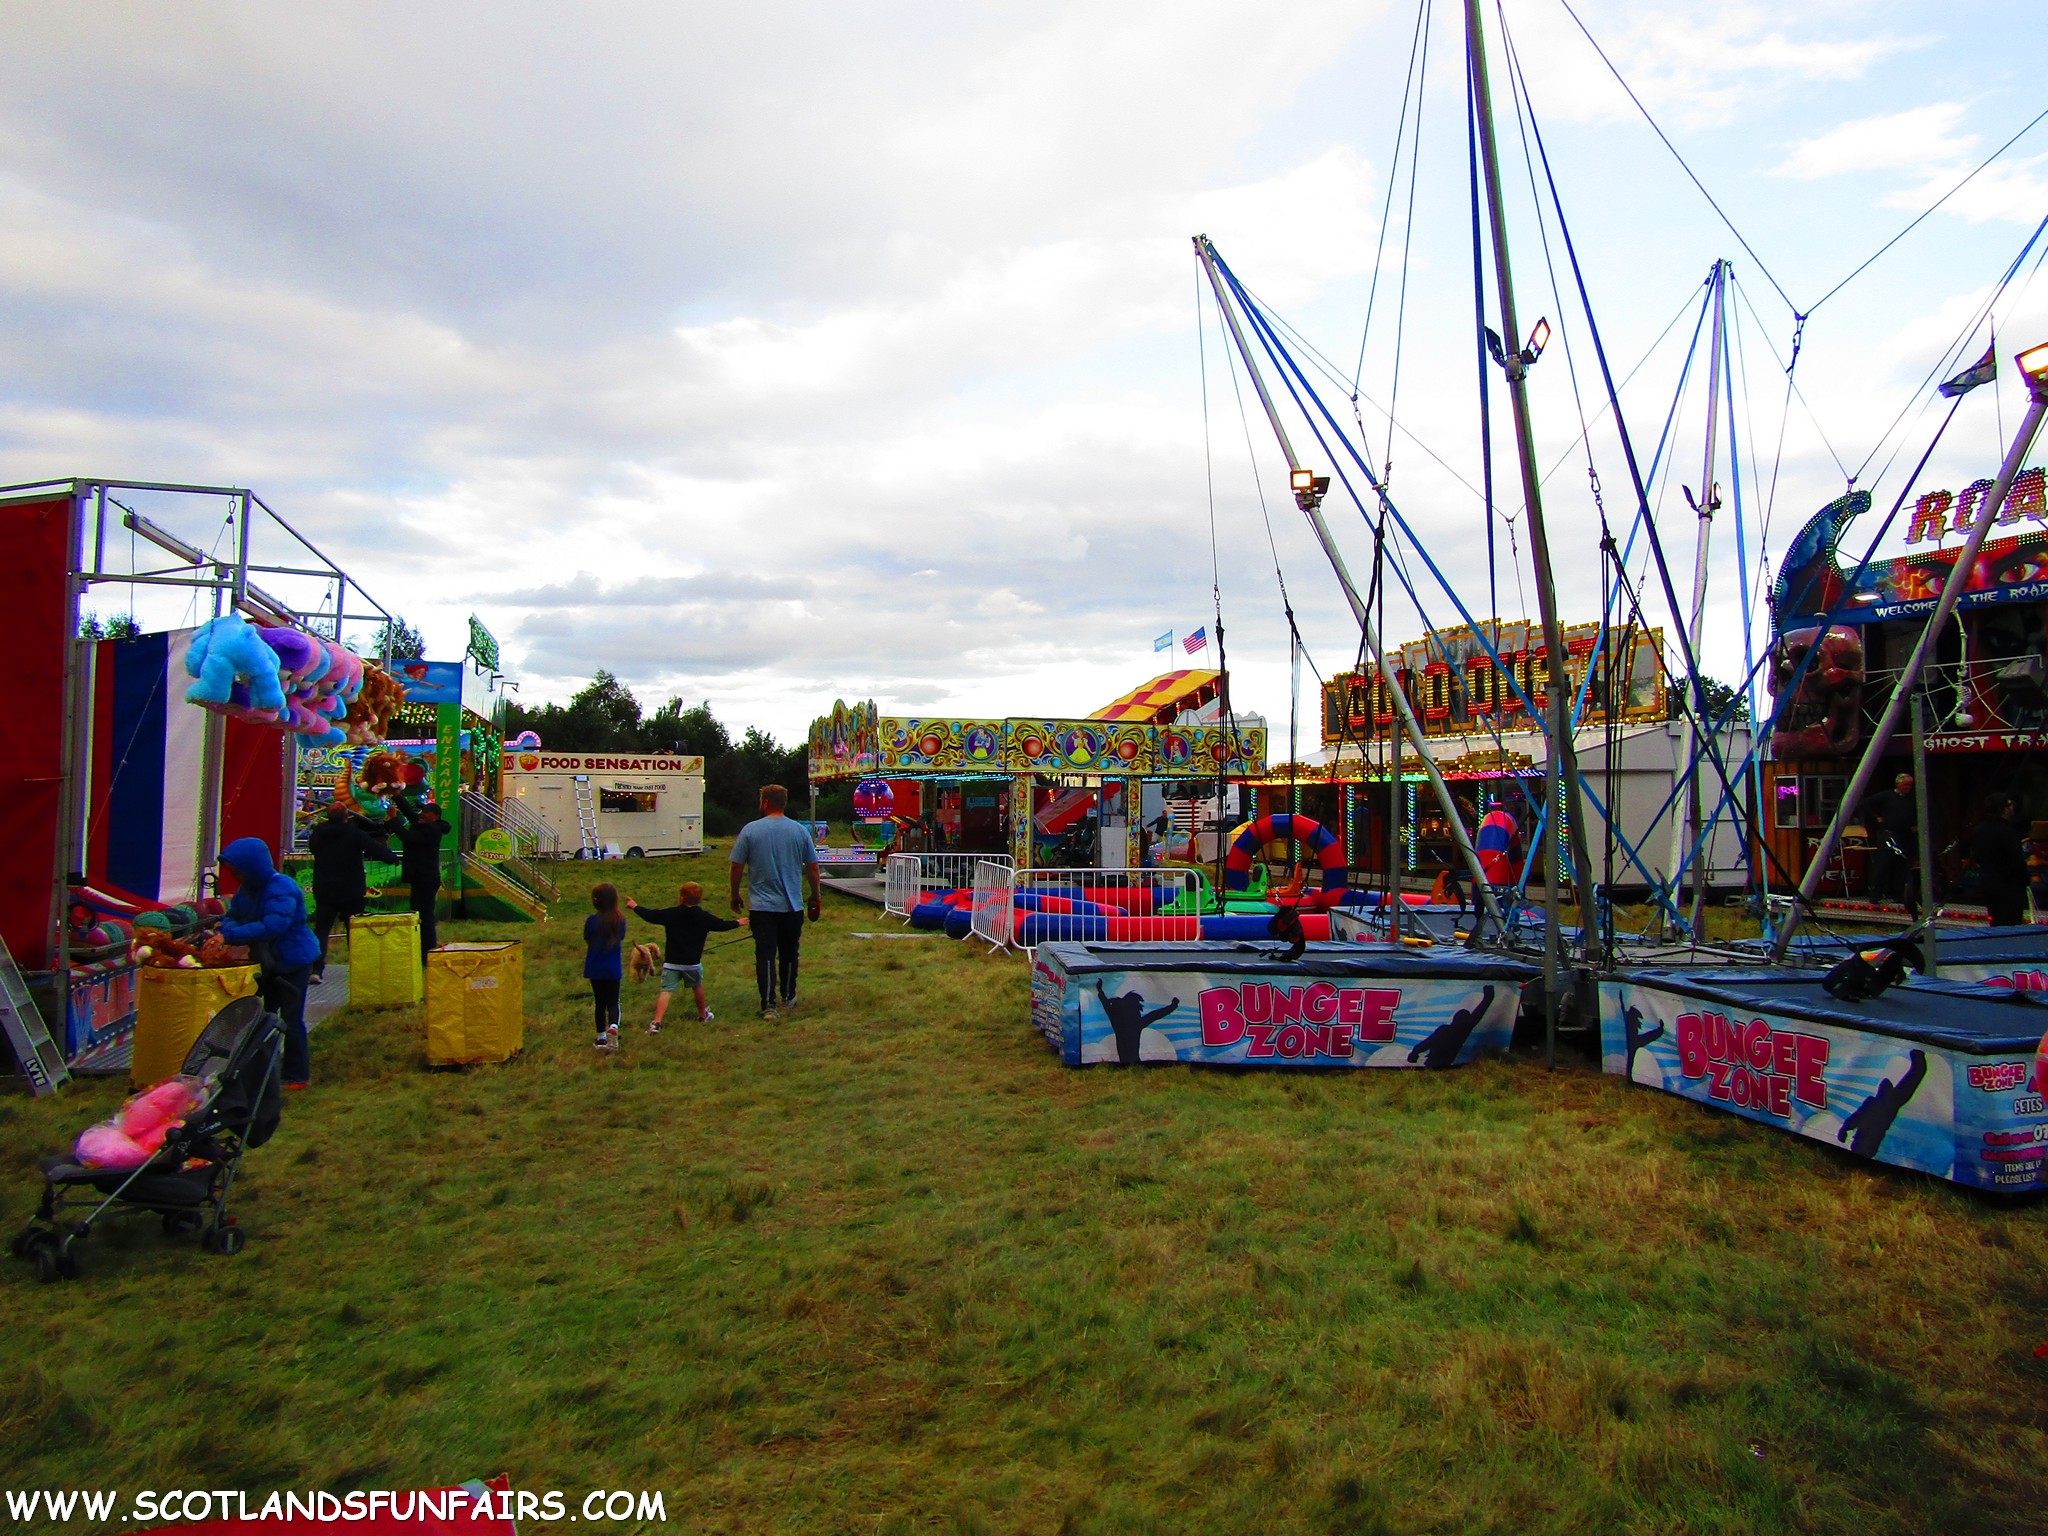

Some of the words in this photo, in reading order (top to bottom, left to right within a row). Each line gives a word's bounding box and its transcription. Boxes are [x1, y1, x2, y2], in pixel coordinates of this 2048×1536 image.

[1875, 600, 1938, 617] WELCOME
[1969, 591, 1998, 602] THE
[1466, 637, 1600, 716] DUST
[1923, 736, 1990, 751] GHOST
[440, 725, 454, 810] ENTRANCE
[541, 758, 580, 769] FOOD
[584, 758, 682, 771] SENSATION
[490, 832, 502, 840] GO
[479, 850, 505, 860] GATOR
[1199, 981, 1402, 1047] BUNGEE
[1246, 1024, 1353, 1058] ZONE
[25, 1059, 47, 1086] LYTE
[1676, 1010, 1830, 1109] BUNGEE
[1968, 1063, 2026, 1087] BUNGEE
[1984, 1080, 2014, 1091] ZONE
[1707, 1060, 1791, 1119] ZONE
